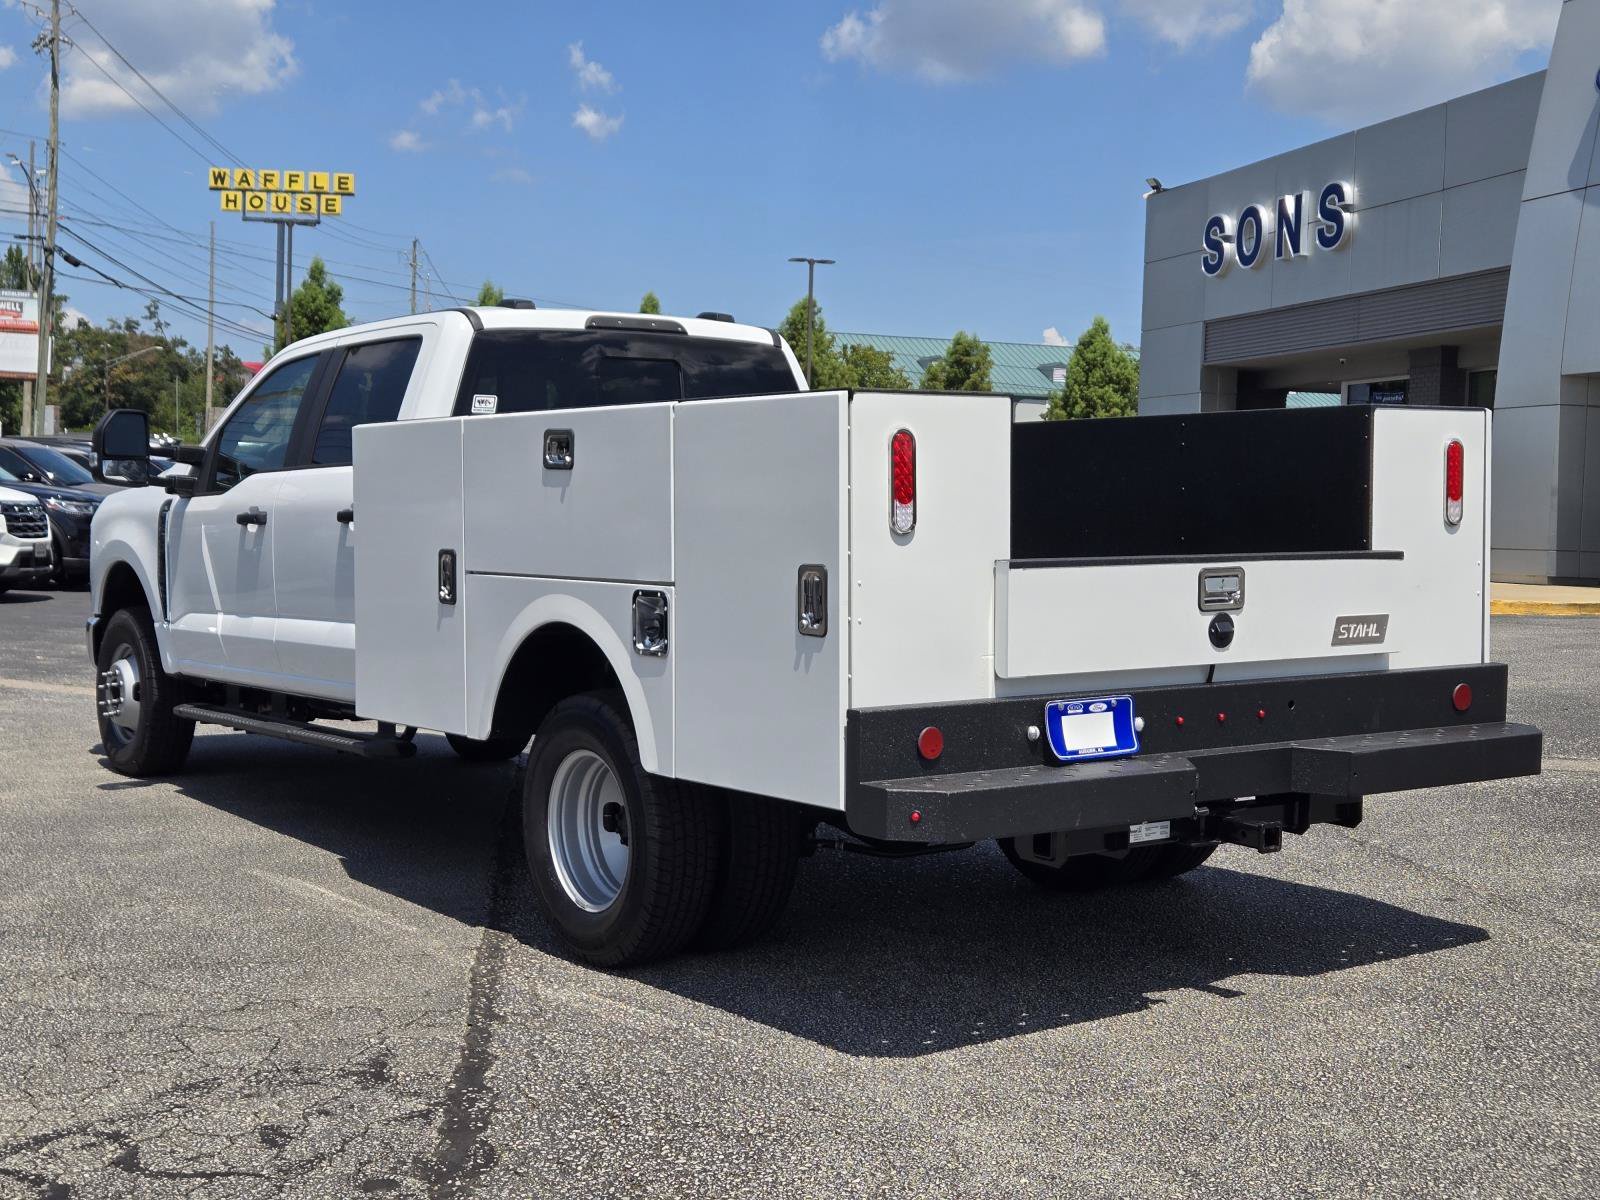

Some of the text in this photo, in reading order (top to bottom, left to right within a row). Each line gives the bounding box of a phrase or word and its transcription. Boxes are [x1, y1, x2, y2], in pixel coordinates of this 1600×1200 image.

[212, 170, 350, 190] WAFFLE
[225, 193, 337, 212] HOUSE
[1201, 181, 1354, 277] SONS
[1338, 622, 1380, 639] STAHL
